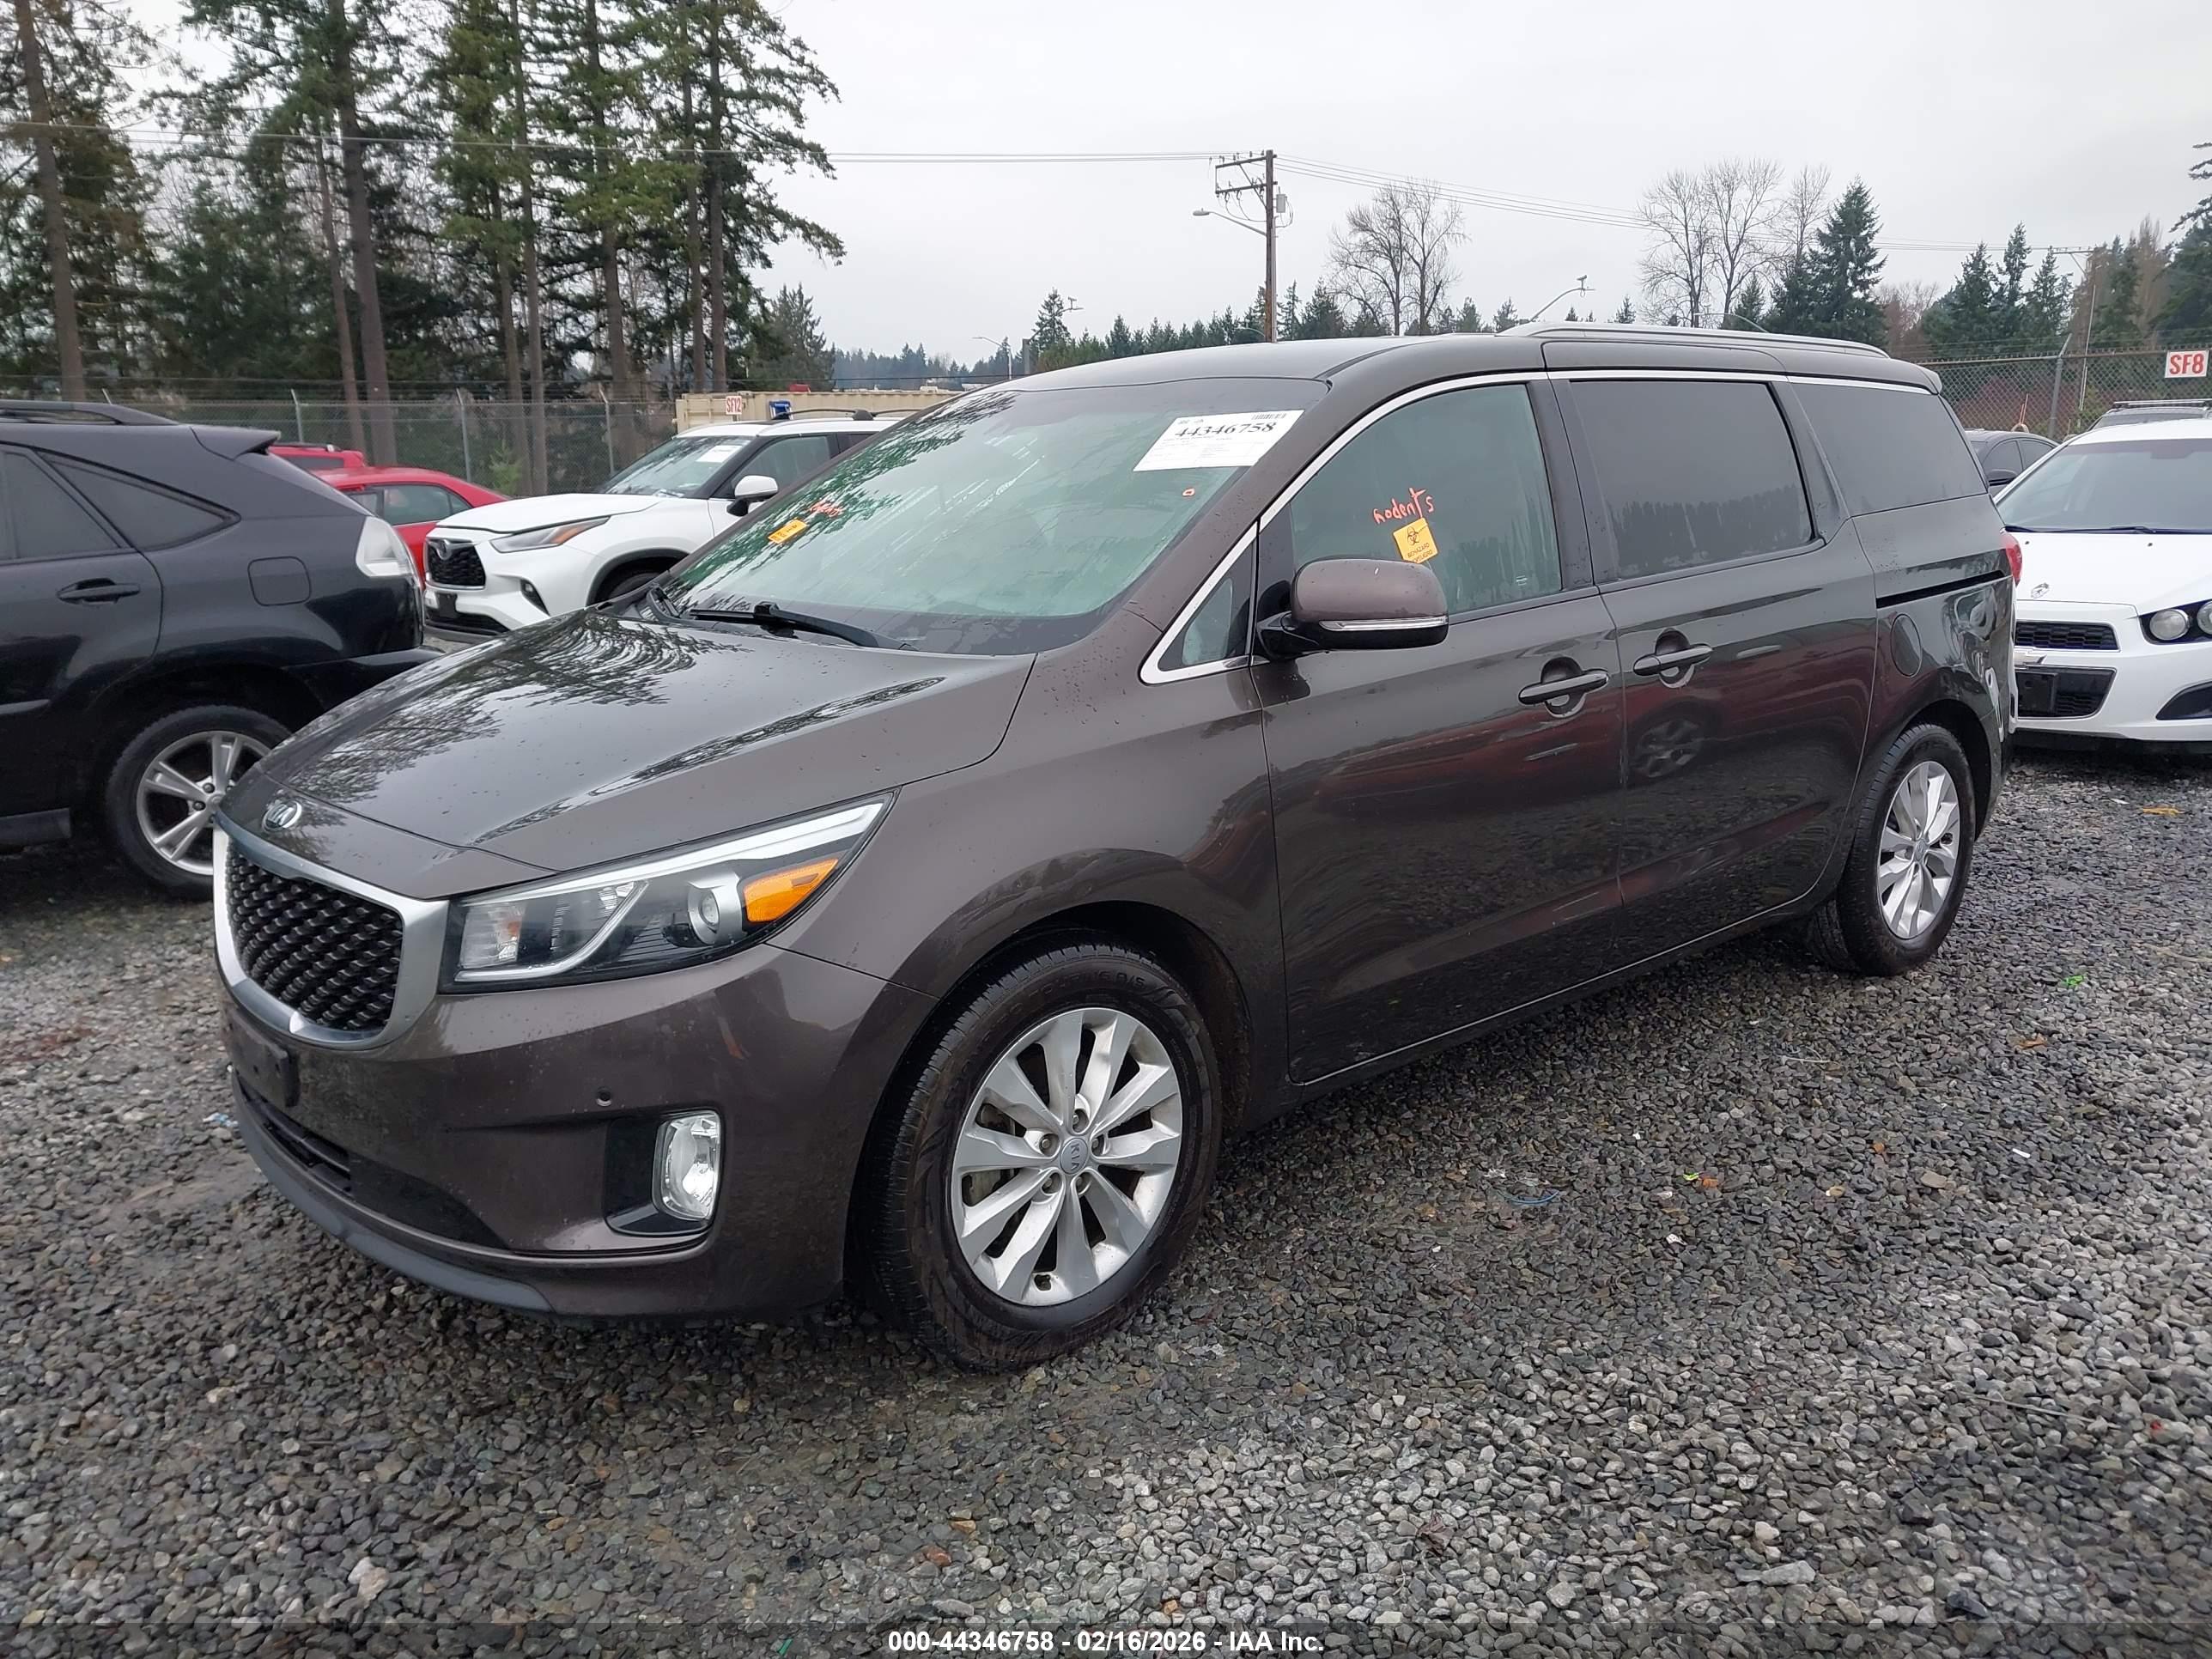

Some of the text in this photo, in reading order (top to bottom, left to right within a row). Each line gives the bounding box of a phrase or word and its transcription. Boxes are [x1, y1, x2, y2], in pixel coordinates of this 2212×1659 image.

[2169, 353, 2204, 375] SF8
[726, 397, 742, 414] SF12
[1174, 421, 1278, 438] 44346758
